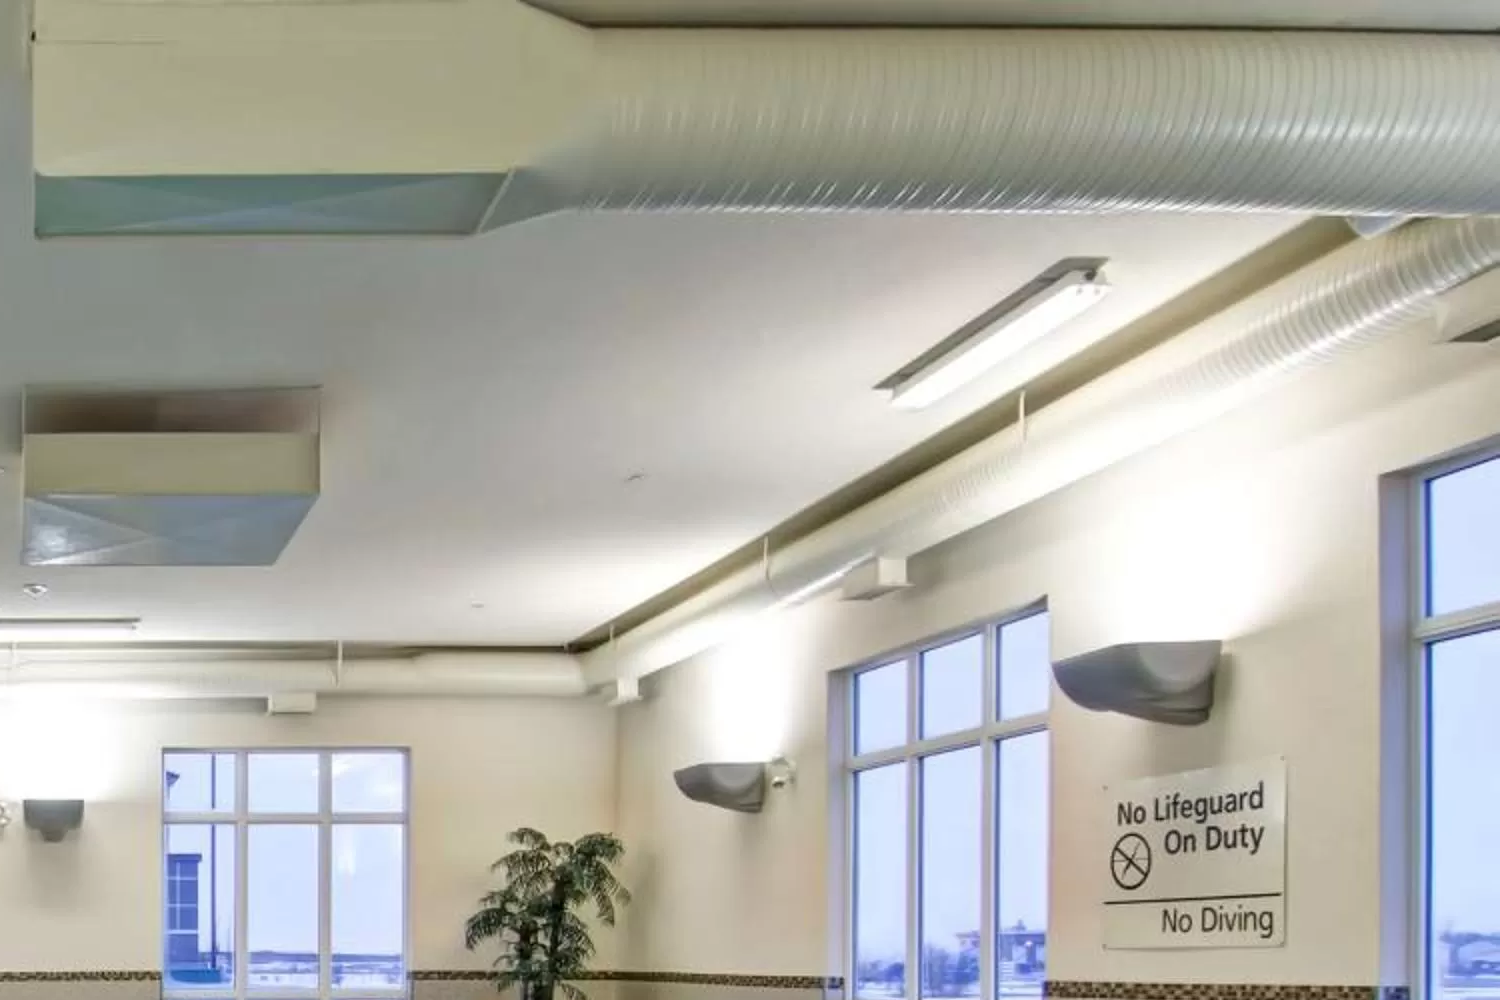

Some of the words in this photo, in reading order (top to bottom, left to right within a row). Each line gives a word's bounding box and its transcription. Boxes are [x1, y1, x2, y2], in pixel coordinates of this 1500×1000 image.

[1117, 802, 1147, 826] No
[1154, 780, 1264, 824] Lifeguard
[1164, 829, 1196, 855] On
[1206, 823, 1265, 855] Duty
[1162, 908, 1192, 933] No
[1202, 904, 1273, 938] Diving
